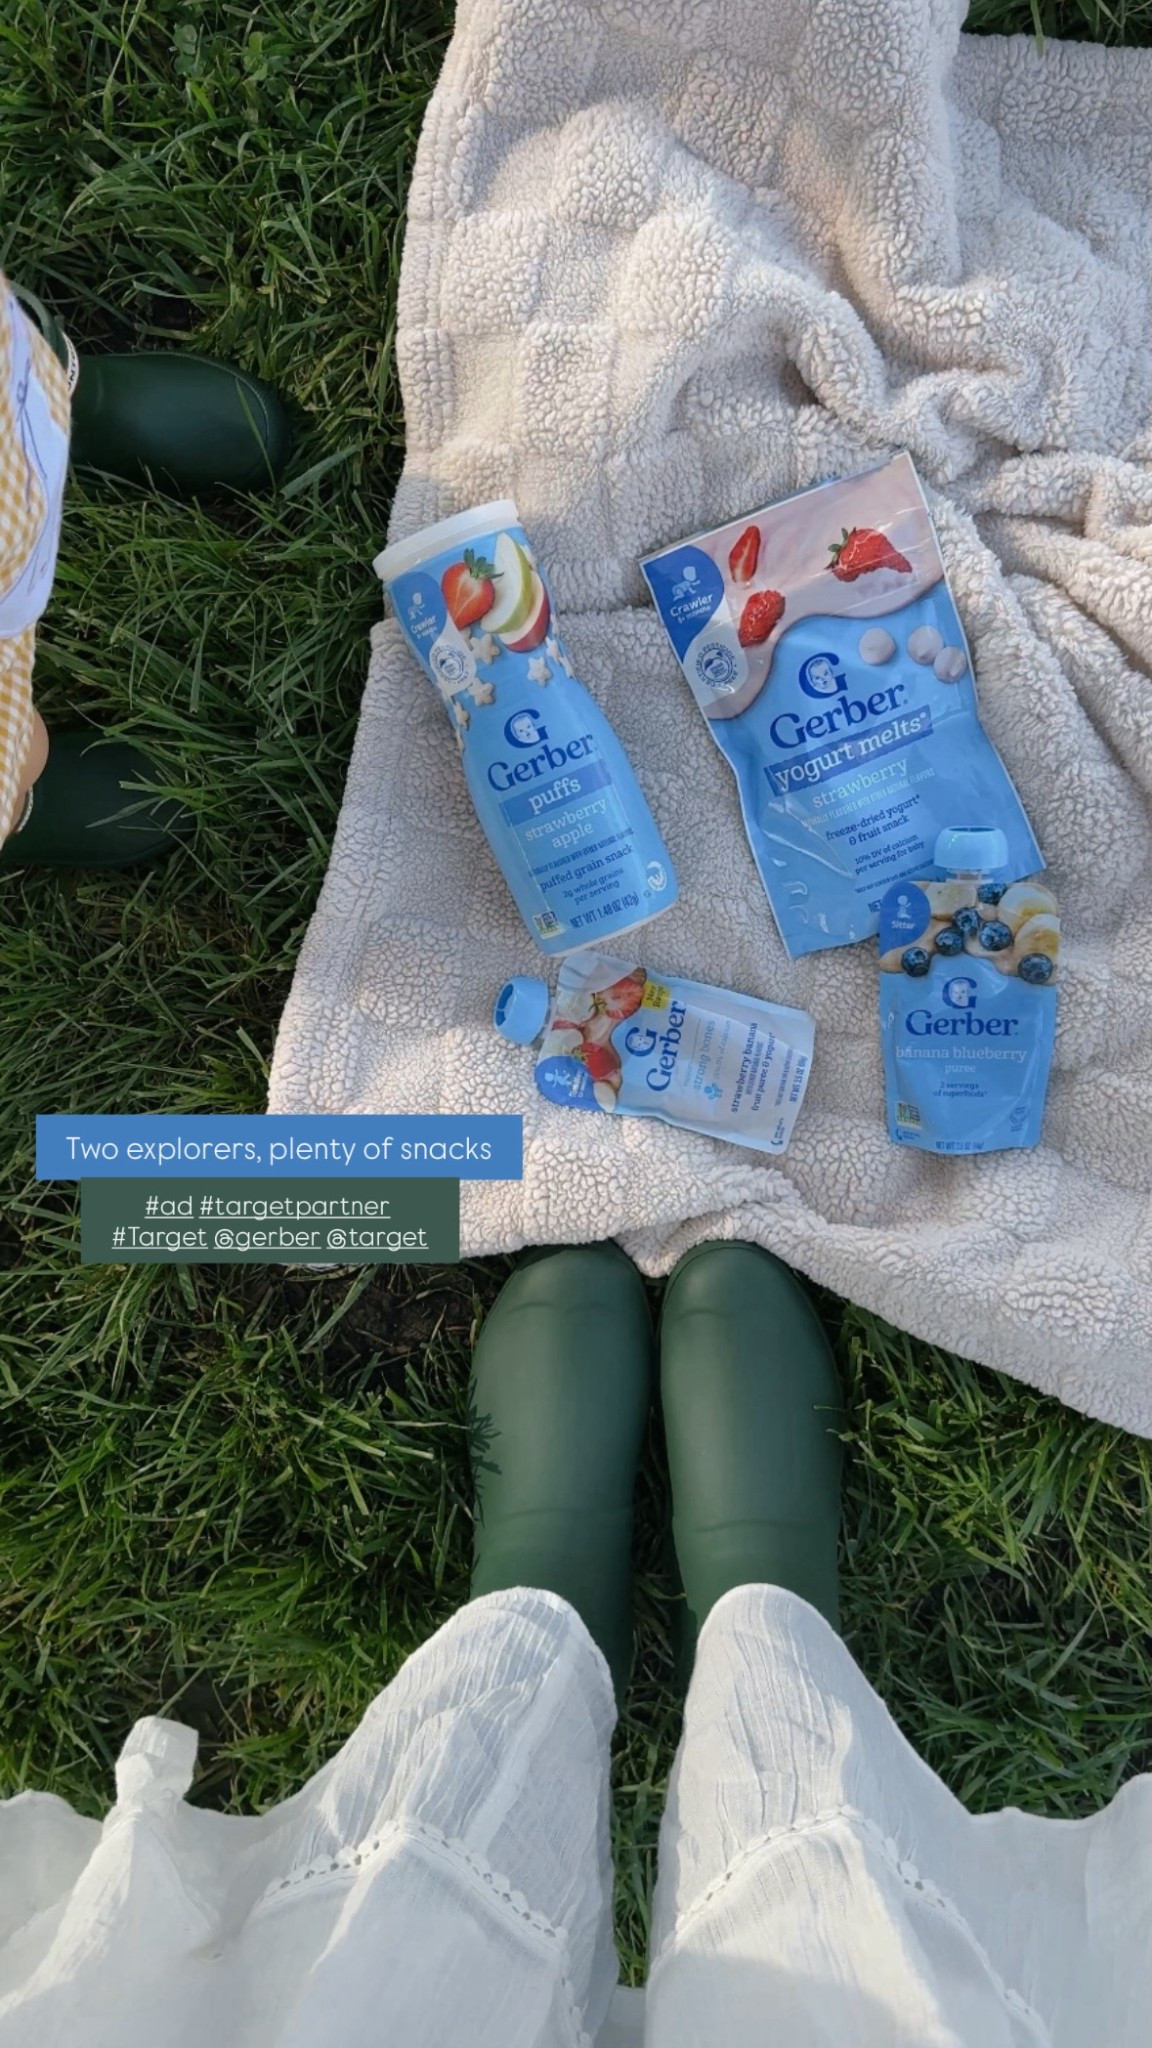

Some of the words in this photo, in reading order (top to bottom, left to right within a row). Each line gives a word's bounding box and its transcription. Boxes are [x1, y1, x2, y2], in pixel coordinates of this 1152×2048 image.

[670, 593, 713, 617] Crawler
[770, 684, 906, 749] Gerber
[488, 734, 594, 792] Gerber
[775, 742, 855, 792] yogurt
[528, 777, 581, 815] puffs
[812, 758, 908, 808] strawberry
[525, 798, 606, 841] strawberry
[552, 823, 594, 848] apple
[826, 809, 887, 841] freeze-dried
[858, 827, 881, 843] fruit
[883, 814, 909, 833] snack
[540, 873, 573, 893] puffed
[574, 858, 604, 879] grain
[605, 843, 633, 864] snack
[573, 878, 598, 893] whole
[589, 880, 620, 899] serving
[569, 916, 584, 929] NET
[583, 911, 597, 926] WT
[905, 1009, 1019, 1036] Gerber
[646, 1001, 686, 1092] Gerber
[896, 1046, 950, 1059] banana
[953, 1047, 1027, 1063] blueberry
[731, 1057, 751, 1113] strawberry
[742, 1022, 757, 1055] banana
[945, 1063, 976, 1074] puree
